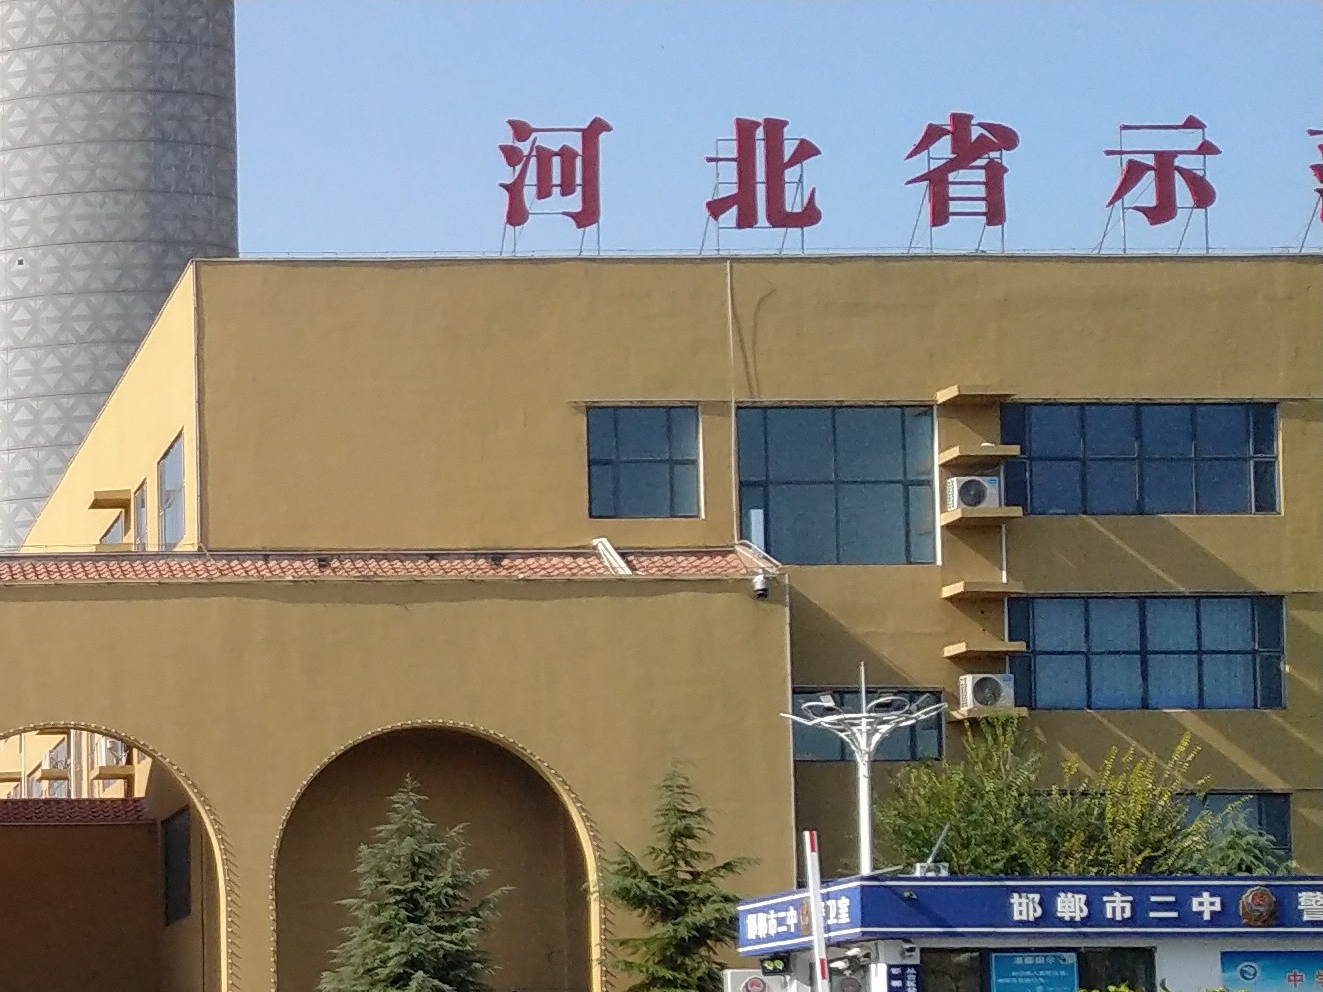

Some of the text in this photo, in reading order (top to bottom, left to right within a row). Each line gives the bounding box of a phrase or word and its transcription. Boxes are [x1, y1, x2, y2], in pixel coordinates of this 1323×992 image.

[498, 112, 1323, 229] 河北省示
[820, 896, 850, 925] 卫室
[1010, 891, 1222, 921] 邯郸市二中
